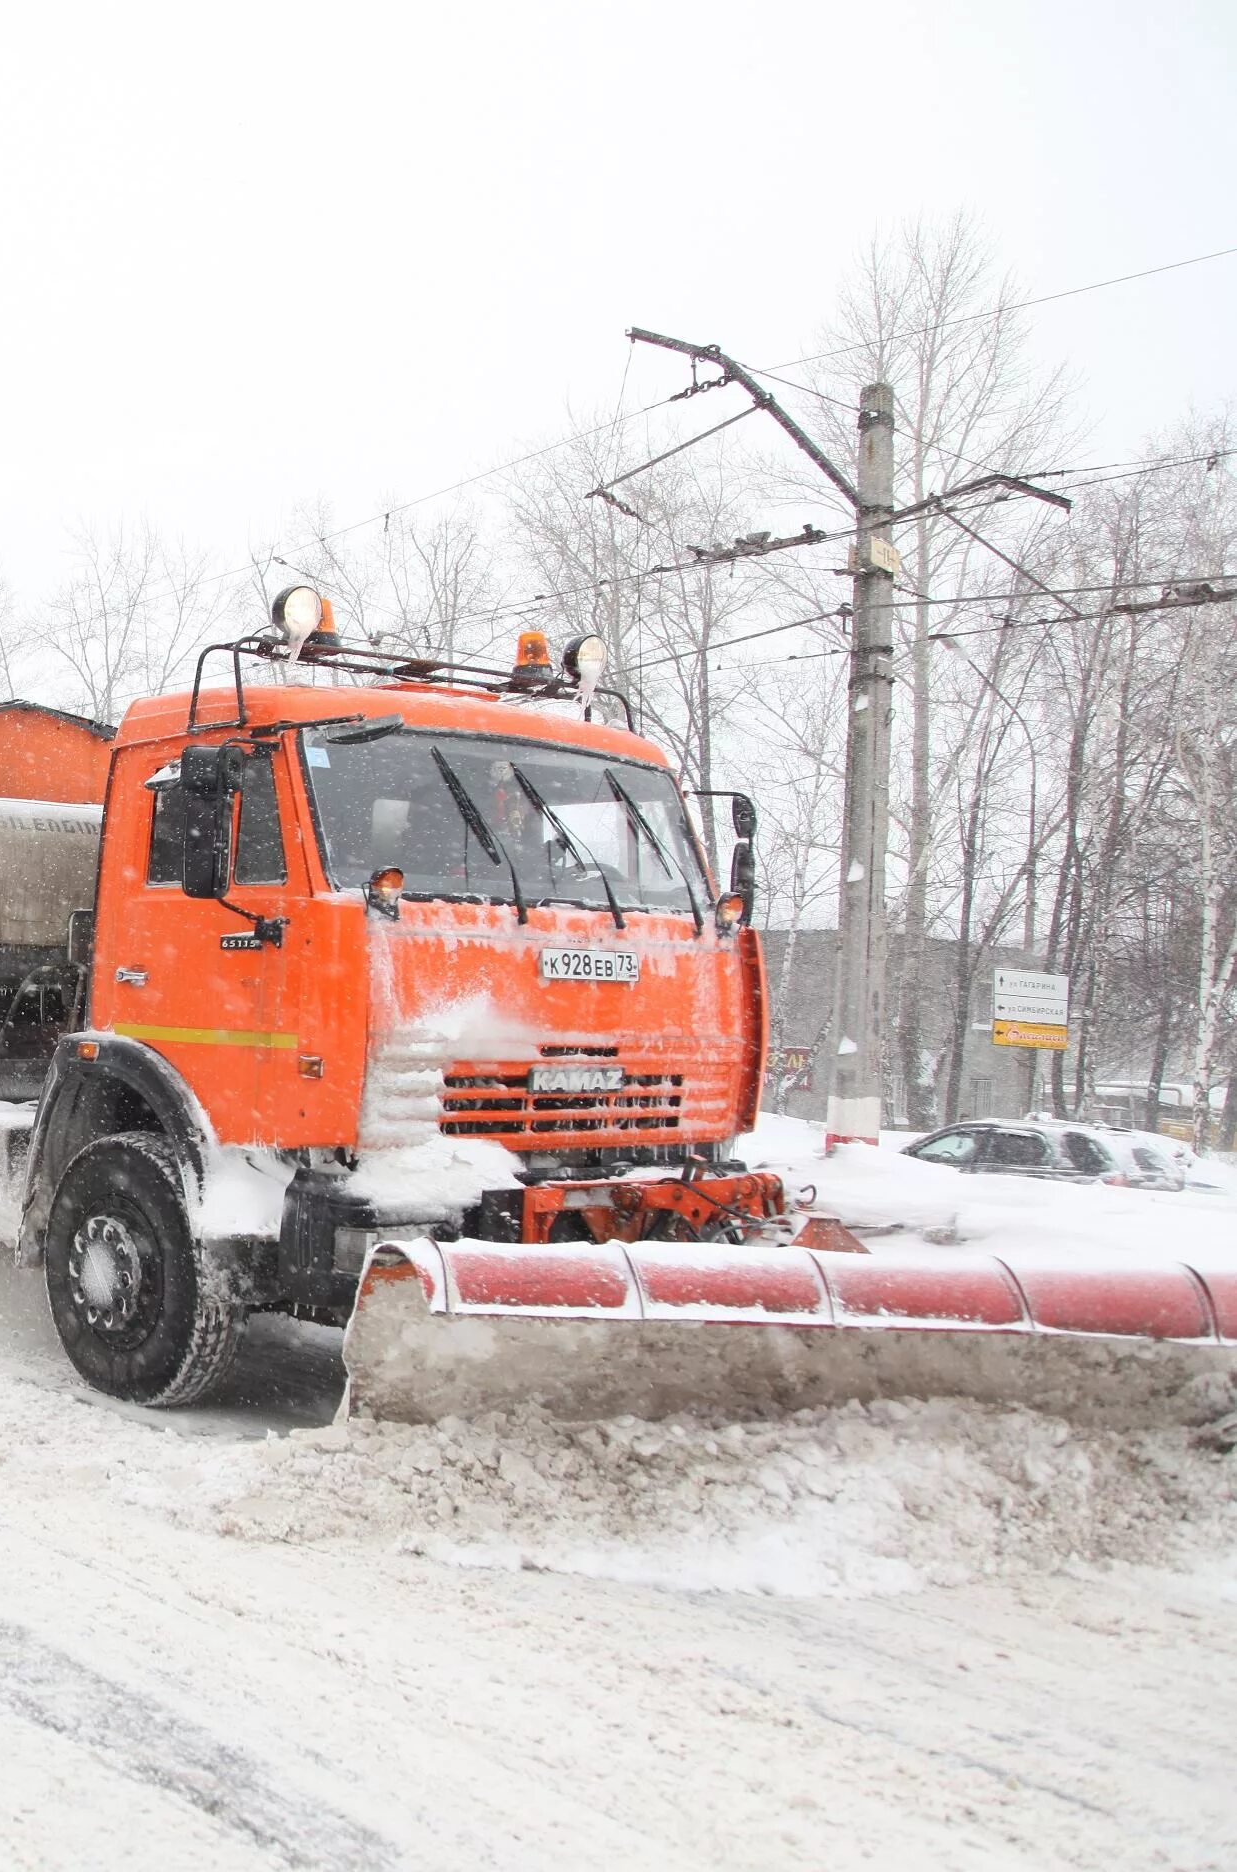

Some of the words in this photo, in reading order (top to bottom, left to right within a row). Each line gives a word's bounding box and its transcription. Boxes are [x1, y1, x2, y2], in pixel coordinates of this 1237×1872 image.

[221, 939, 256, 948] 65115
[617, 954, 633, 972] 73
[532, 1070, 623, 1092] KAMAZ
